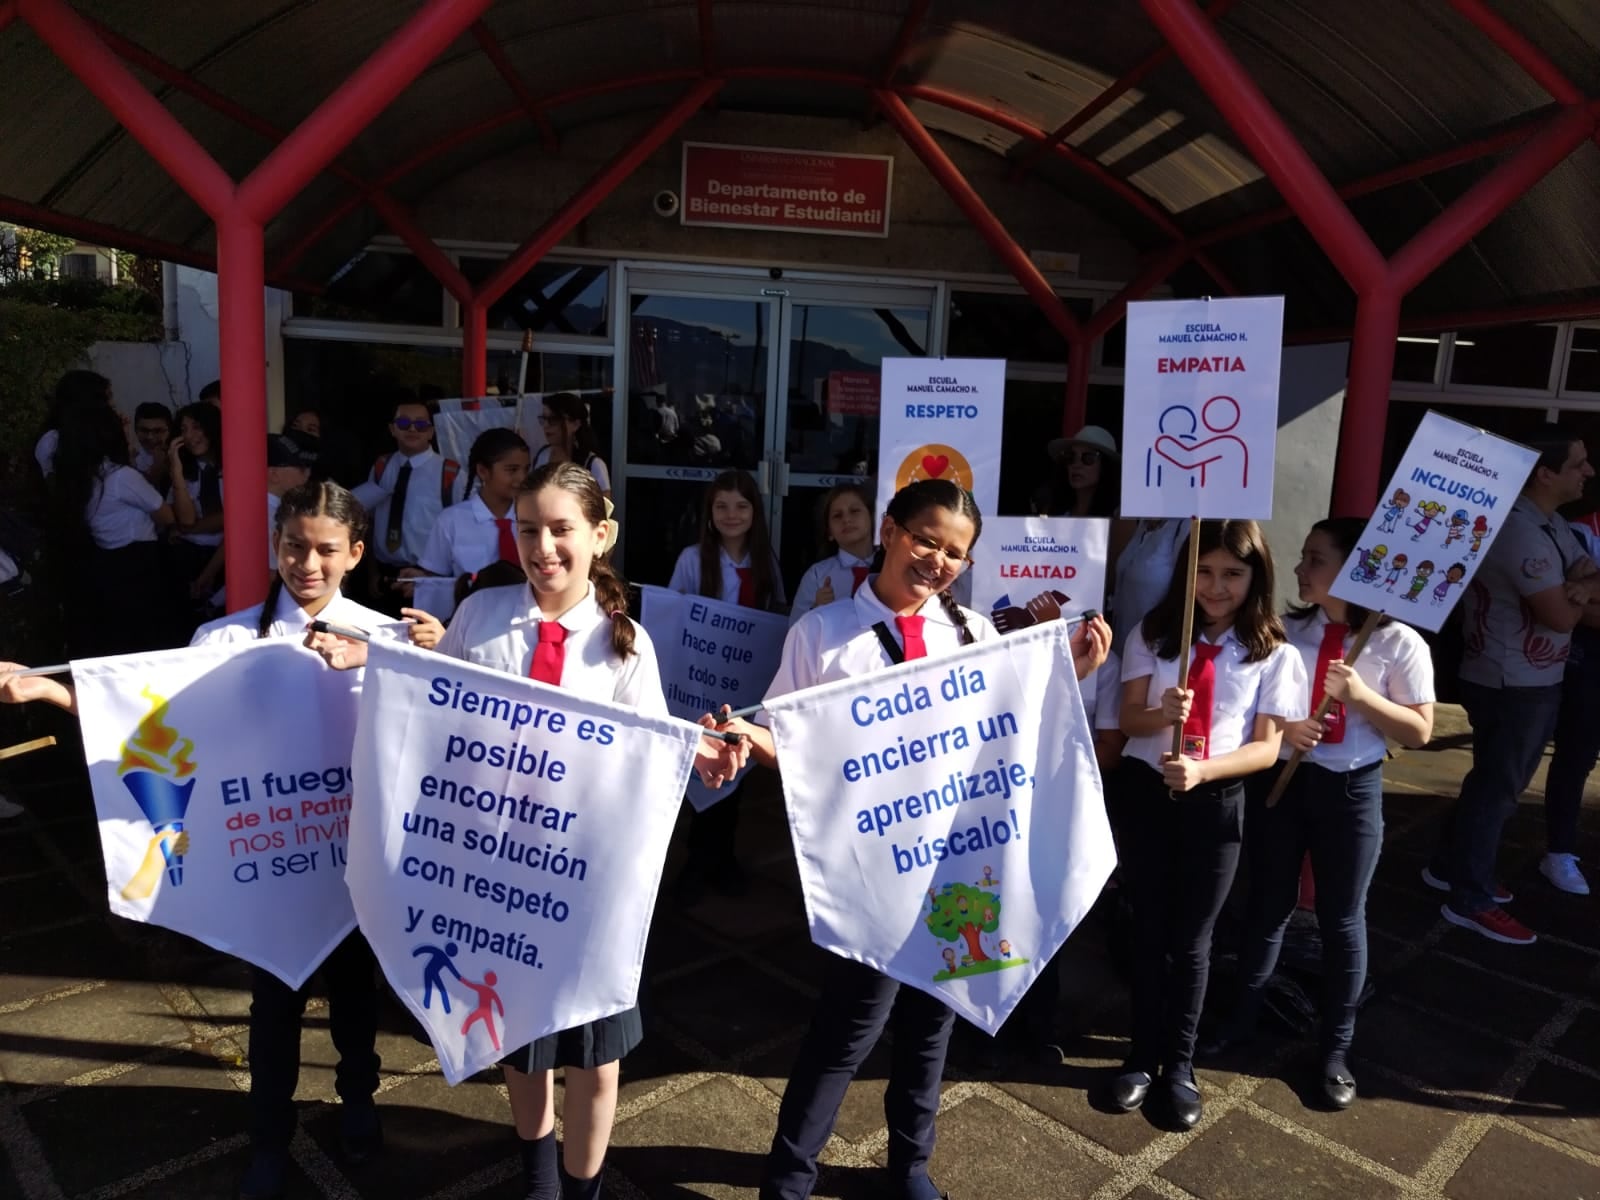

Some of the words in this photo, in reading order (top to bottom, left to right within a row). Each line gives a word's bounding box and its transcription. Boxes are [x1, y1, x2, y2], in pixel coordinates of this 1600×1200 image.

[707, 179, 838, 203] Departamento
[843, 188, 866, 204] de
[690, 197, 779, 218] Bienestar
[783, 203, 881, 225] Estudiantil
[1158, 333, 1192, 343] MANUEL
[1193, 332, 1237, 343] CAMACHO
[1239, 332, 1248, 342] H.
[1185, 323, 1221, 333] ESCUELA
[928, 376, 958, 385] ESCUELA
[1157, 356, 1246, 374] EMPATIA
[907, 385, 934, 393] MANUEL
[935, 385, 970, 393] CAMACHO
[905, 404, 978, 419] RESPETO
[1433, 449, 1458, 465] MANUEL
[1459, 459, 1492, 477] CAMACHO
[1457, 448, 1484, 464] ESCUELA
[1410, 467, 1498, 510] INCLUSIÓN
[1024, 536, 1055, 544] ESCUELA
[1031, 545, 1069, 553] CAMACHO
[1071, 545, 1078, 553] H.
[1000, 564, 1076, 579] LEALTAD
[690, 602, 708, 624] El
[711, 611, 755, 636] amor
[682, 628, 717, 655] hace
[721, 643, 753, 665] que
[688, 664, 717, 687] todo
[720, 675, 740, 691] se
[428, 677, 566, 734] Siempre
[577, 718, 616, 745] es
[851, 683, 932, 727] Cada
[940, 666, 986, 702] día
[445, 734, 566, 782] posible
[843, 725, 969, 783] encierra
[977, 711, 1018, 742] un
[221, 777, 251, 805] El
[262, 765, 352, 798] fueg
[856, 758, 1036, 837] aprendizaje,
[226, 812, 260, 831] de
[269, 806, 292, 823] la
[301, 793, 352, 818] Patri
[420, 774, 577, 833] encontrar
[229, 830, 285, 857] nos
[295, 815, 349, 846] invit
[402, 812, 455, 844] una
[462, 828, 587, 881] solución
[891, 809, 1021, 874] búscalo!
[234, 861, 259, 883] a
[272, 851, 319, 877] ser
[402, 855, 455, 888] con
[463, 872, 569, 923] respeto
[404, 905, 424, 933] y
[431, 913, 544, 969] empatía.
